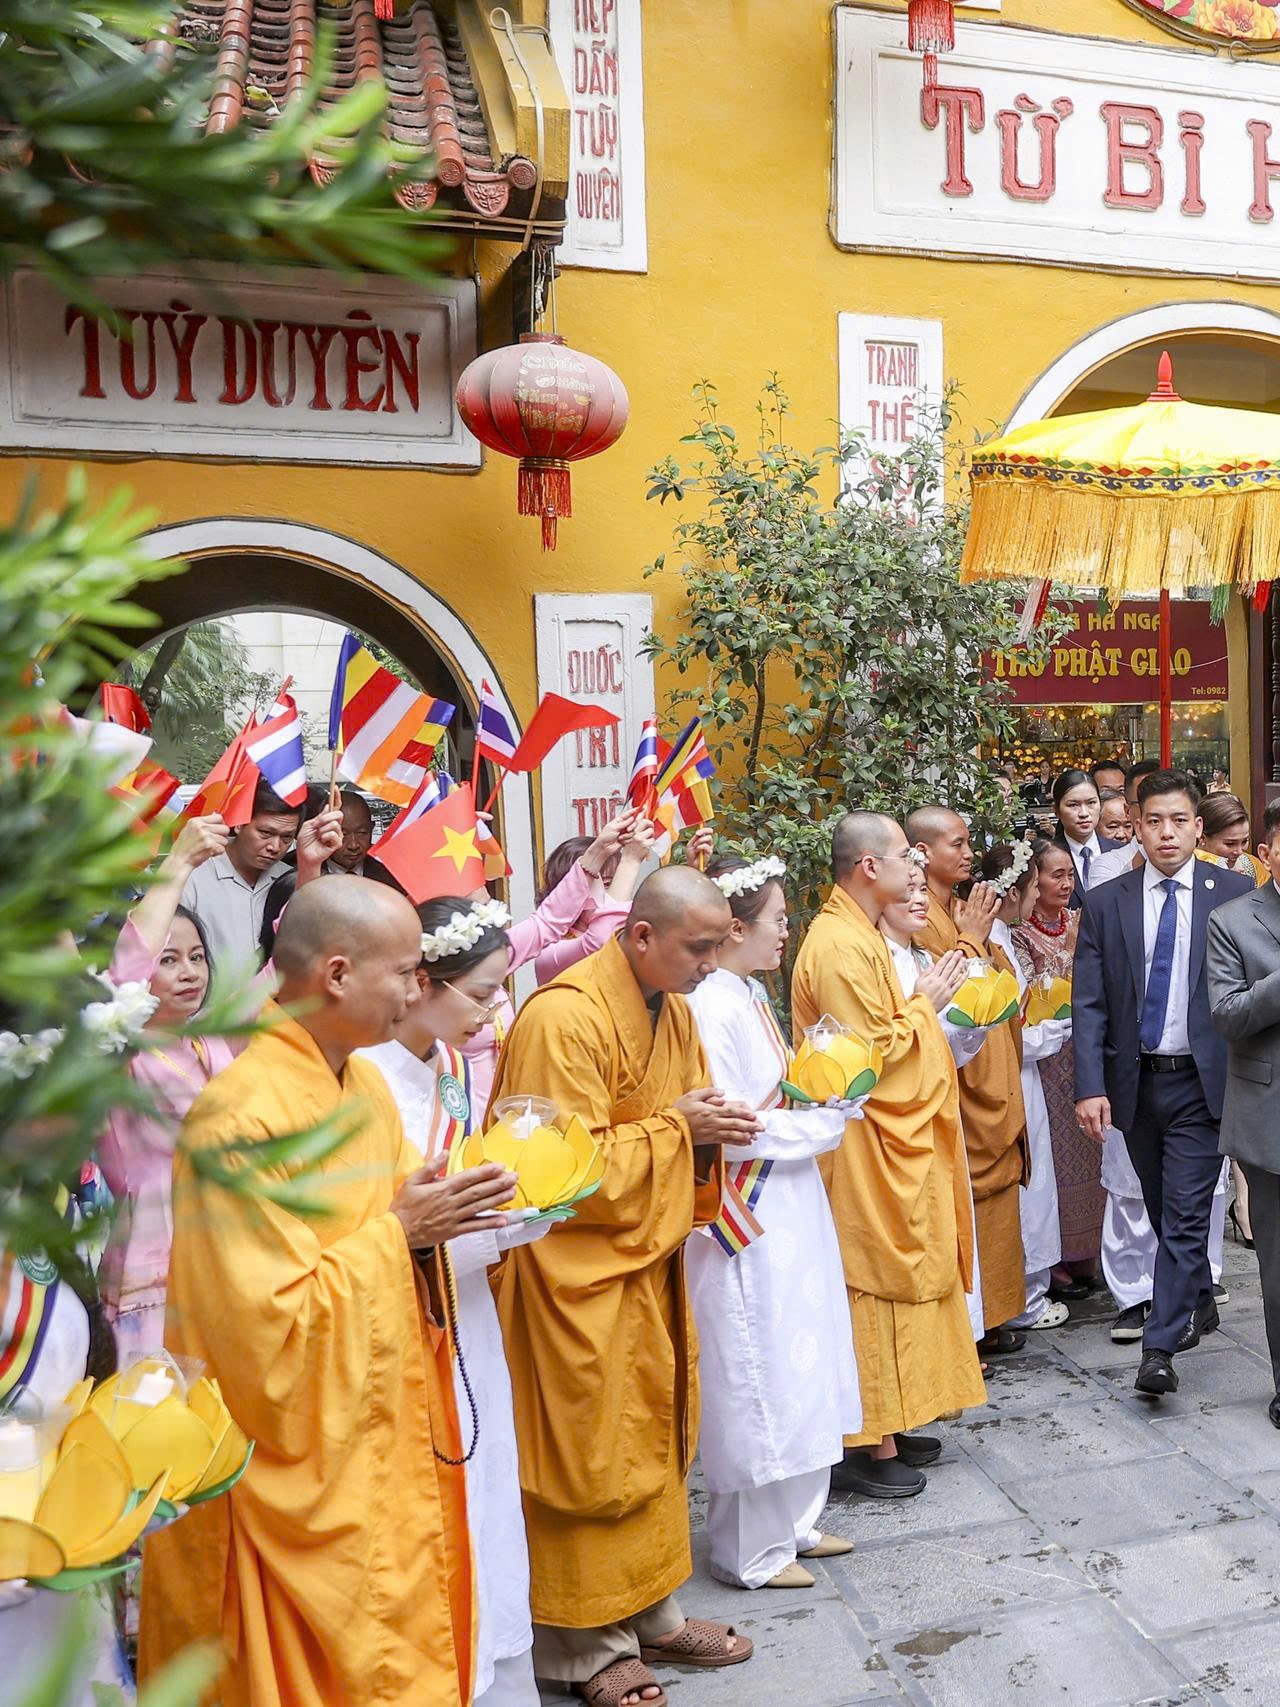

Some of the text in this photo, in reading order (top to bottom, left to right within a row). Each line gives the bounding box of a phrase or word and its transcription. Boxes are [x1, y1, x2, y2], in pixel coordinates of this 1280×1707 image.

[921, 86, 1073, 202] TỪ
[216, 309, 421, 413] DUYÊN
[866, 344, 919, 388] TRANH
[868, 392, 917, 443] THẾ
[1053, 640, 1122, 684] PHẬT
[1131, 647, 1192, 676] GIO
